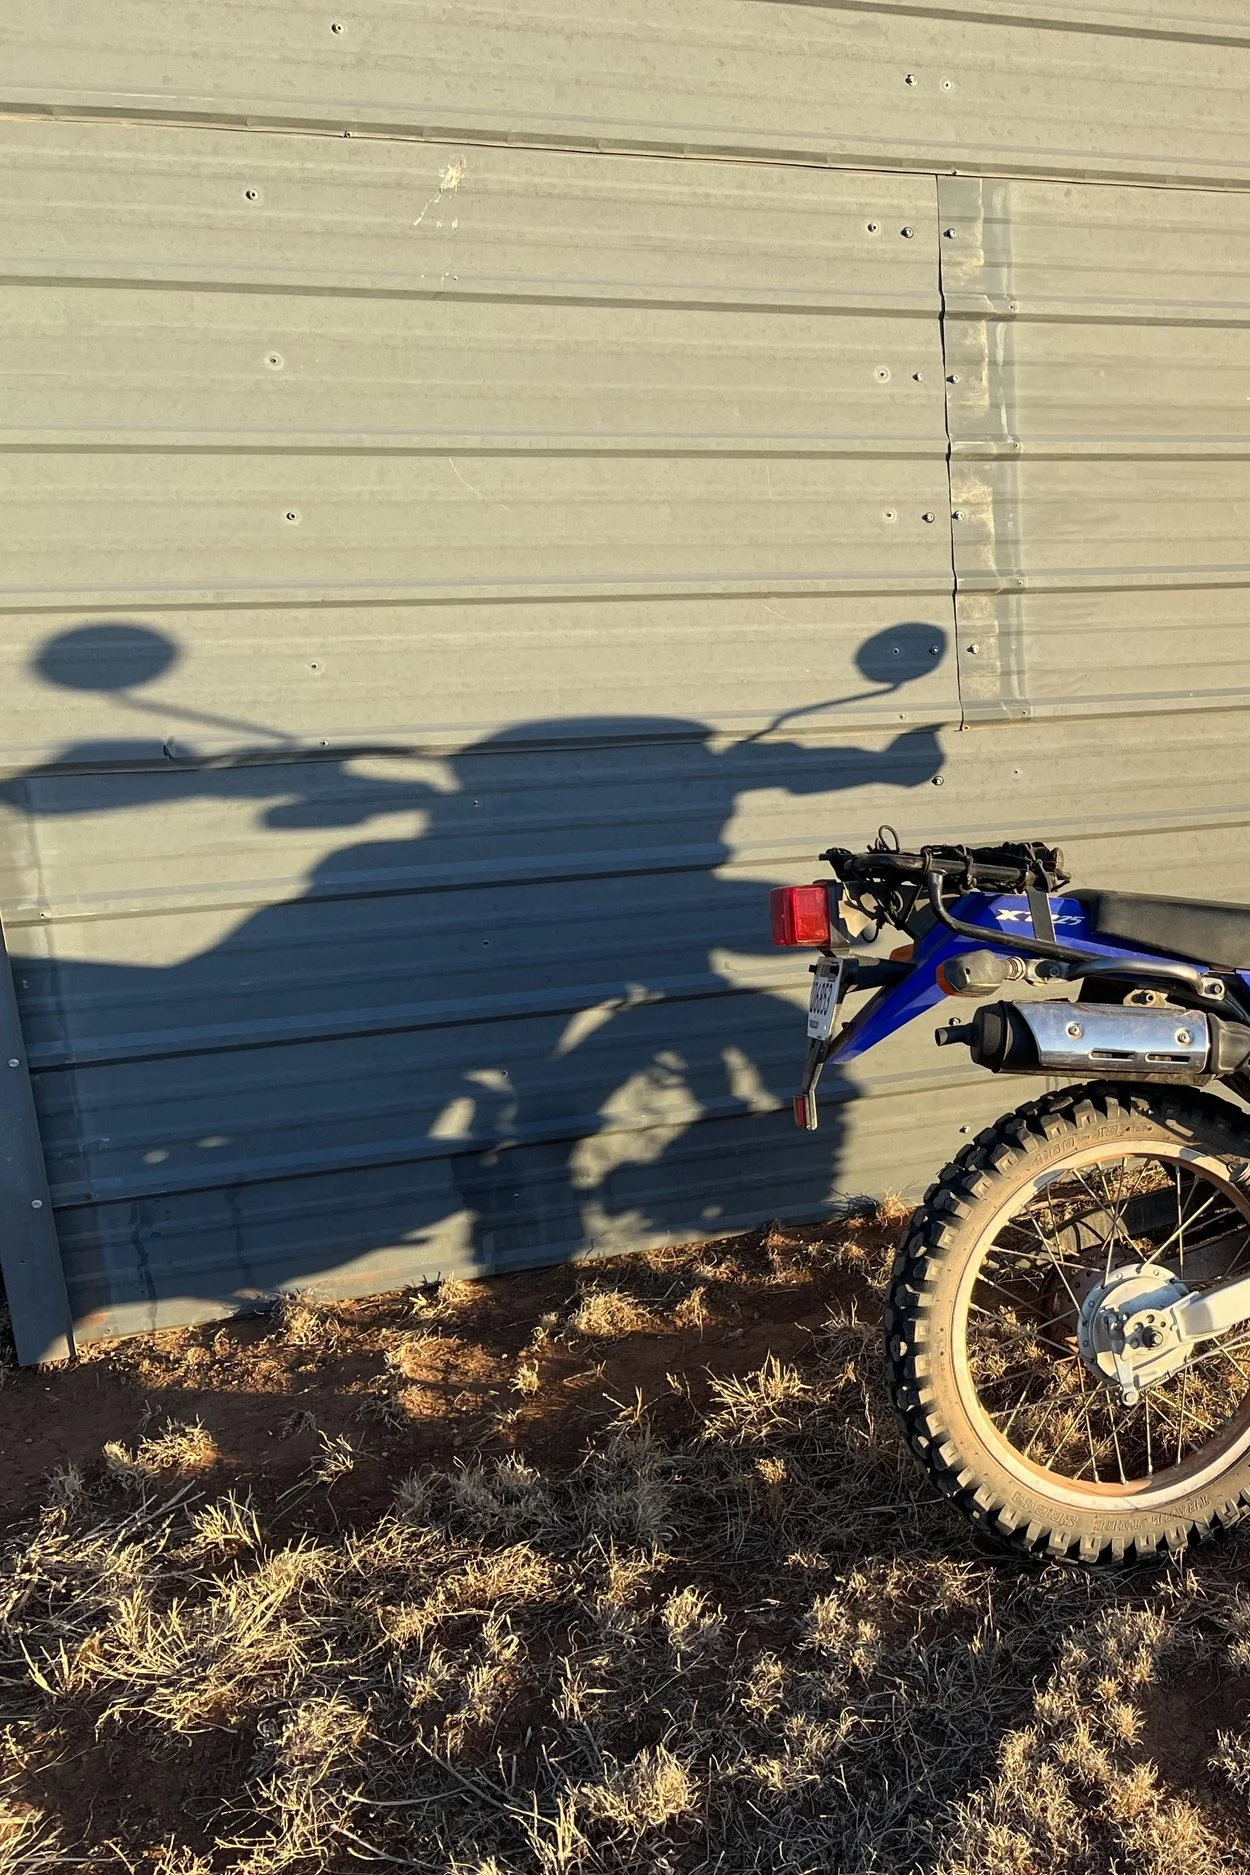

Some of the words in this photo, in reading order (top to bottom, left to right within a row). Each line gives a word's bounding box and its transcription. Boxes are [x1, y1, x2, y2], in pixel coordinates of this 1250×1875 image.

[995, 909, 1085, 926] X25
[1151, 1494, 1211, 1527] TRAIL
[1093, 1518, 1142, 1532] TIRE
